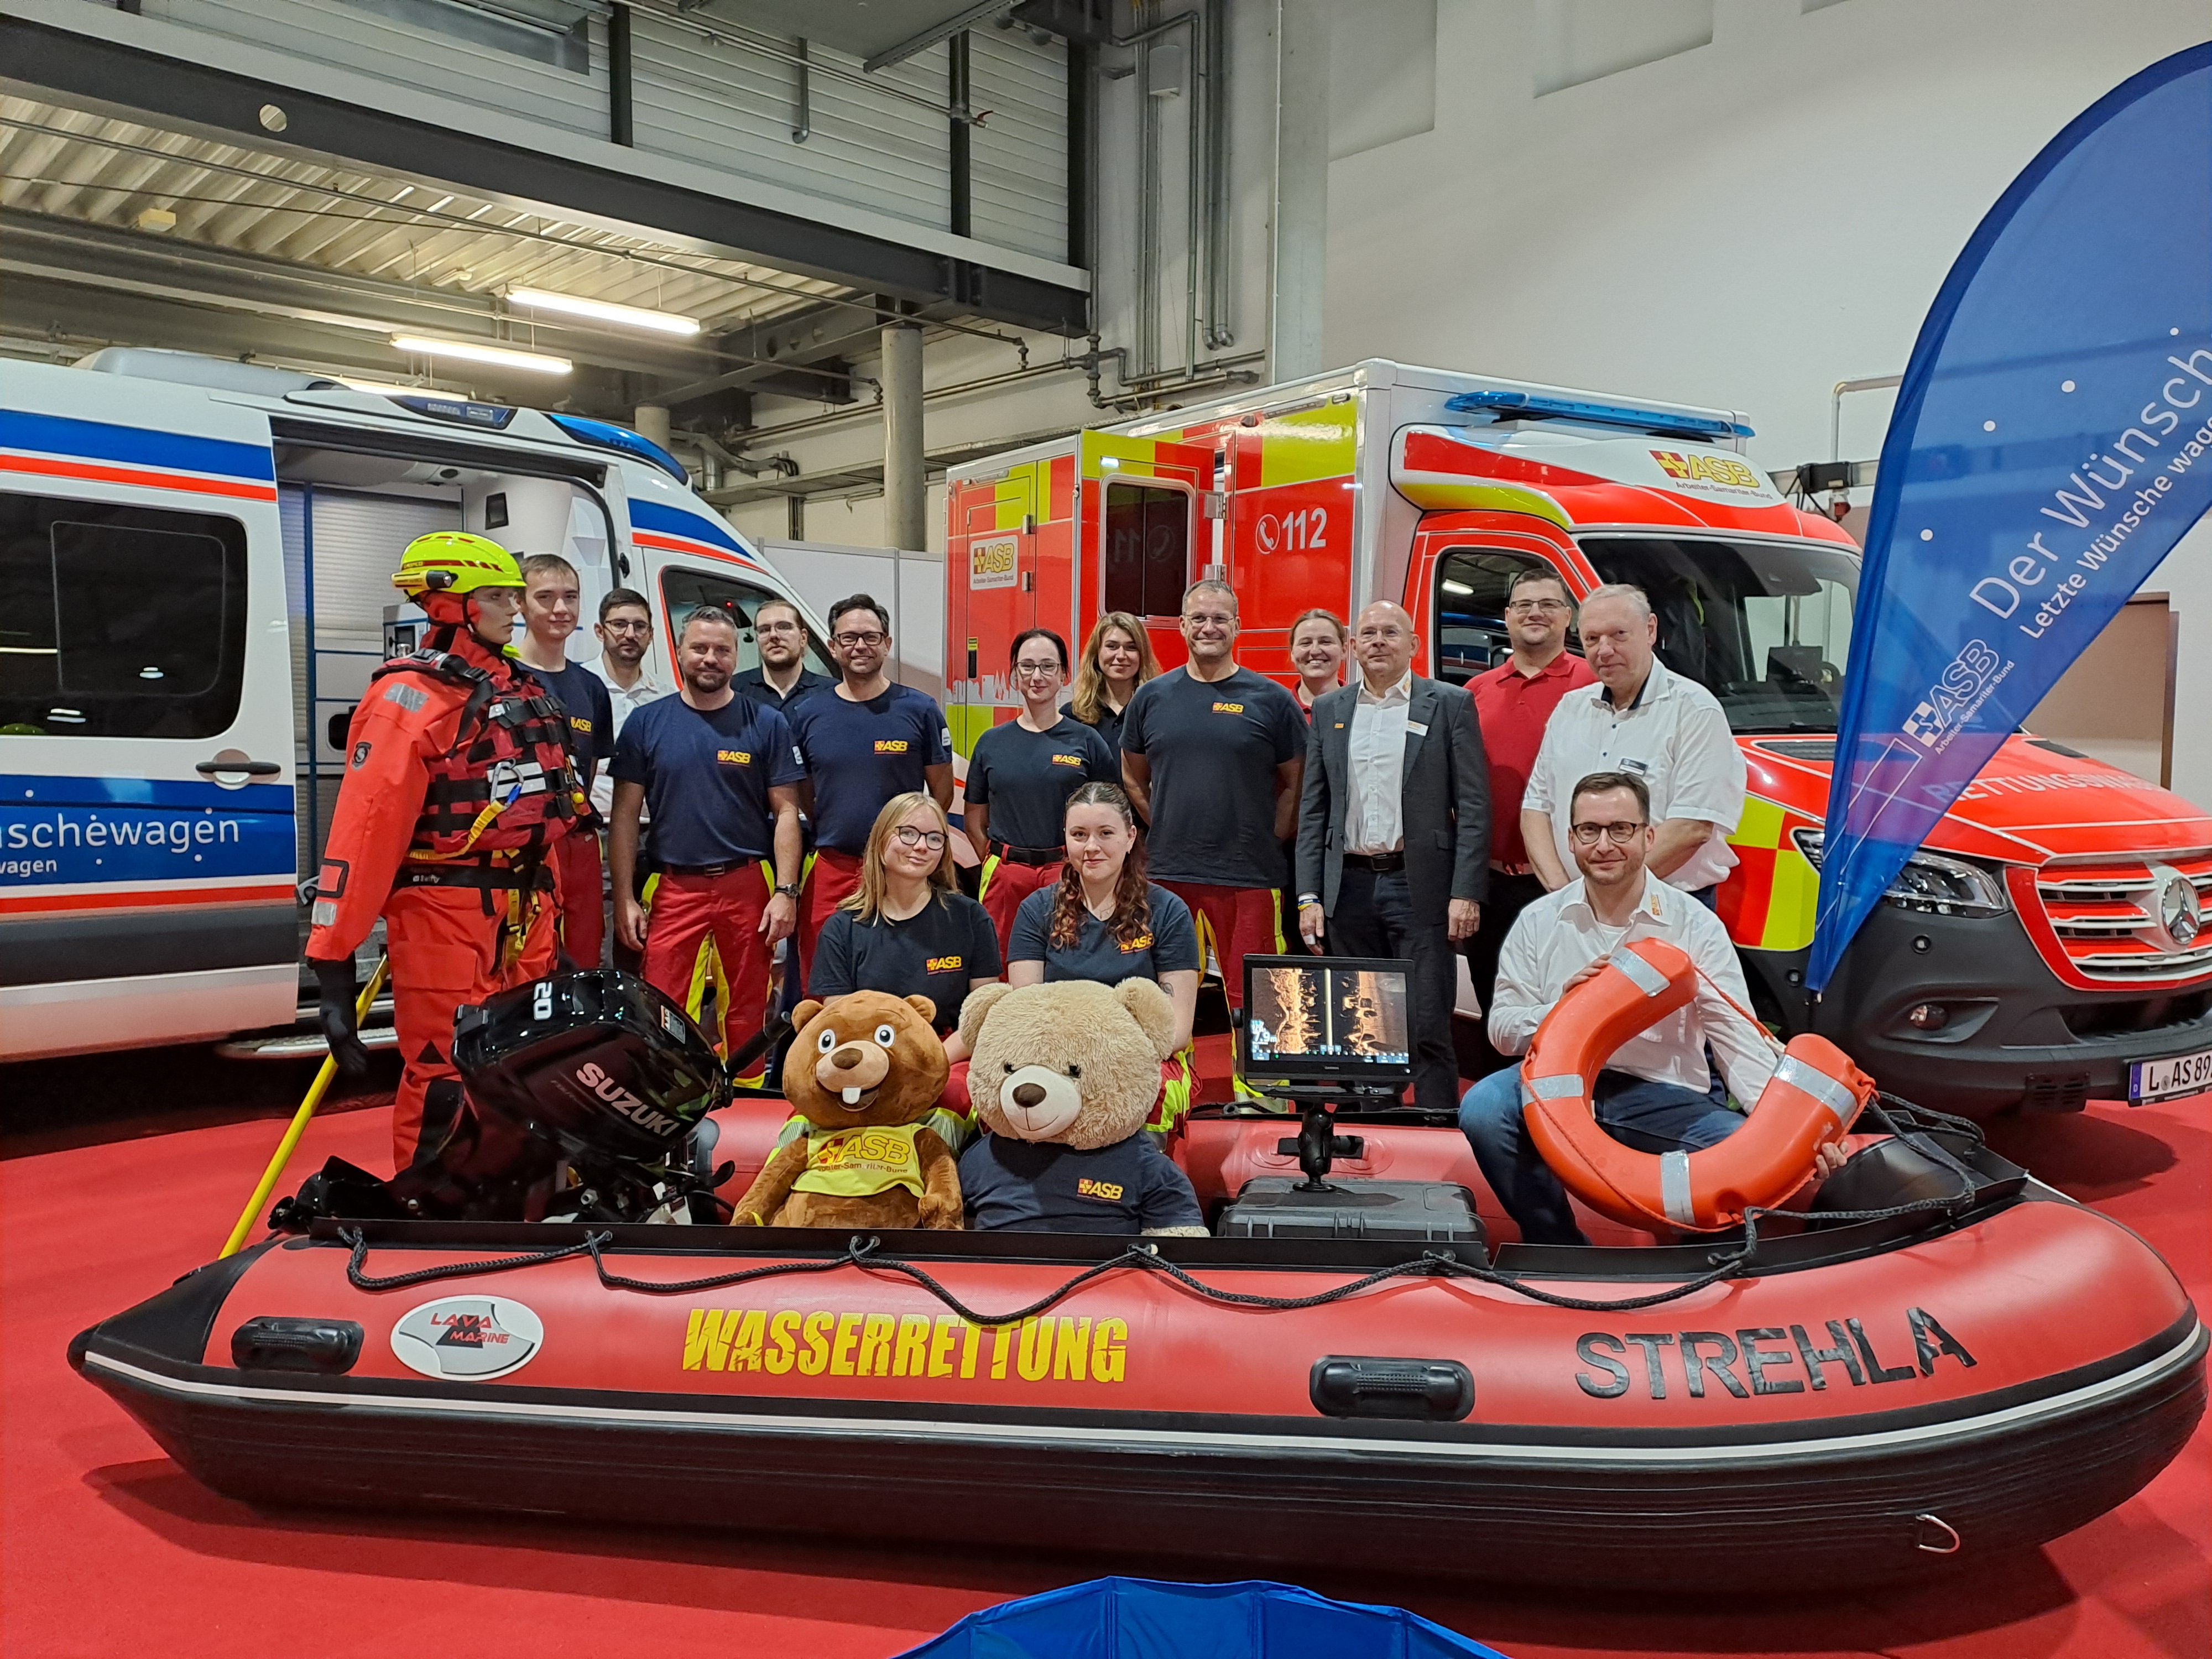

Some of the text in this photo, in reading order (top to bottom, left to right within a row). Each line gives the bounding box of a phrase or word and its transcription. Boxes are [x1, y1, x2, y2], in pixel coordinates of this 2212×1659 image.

[1688, 454, 1760, 488] ASB
[1676, 481, 1773, 499] Arbeiter-Samariter-Bund
[1282, 507, 1327, 551] 112
[2019, 416, 2212, 639] Letzte Wünsche wag
[982, 543, 1014, 573] ASB
[1969, 531, 2059, 619] Der
[1929, 639, 2000, 728] ASB
[1219, 703, 1244, 713] ASB
[1935, 659, 2015, 755] Arbeiter-Samariter-Bund
[573, 718, 592, 732] ASB
[726, 751, 751, 764] ASB
[882, 740, 908, 752] ASB
[1059, 755, 1082, 766] ASB
[0, 812, 239, 854] schewagen
[935, 956, 962, 969] ASB
[534, 982, 553, 1021] 20
[2149, 1055, 2212, 1091] L AS 89
[576, 1062, 681, 1136] SUZUKI
[835, 1135, 911, 1165] ASB
[1088, 1181, 1124, 1199] ASB
[430, 1312, 492, 1329] LAVA
[450, 1331, 510, 1344] MARINE
[682, 1308, 1129, 1383] WASSERRETTUNG
[1574, 1306, 1978, 1400] STREHLA
